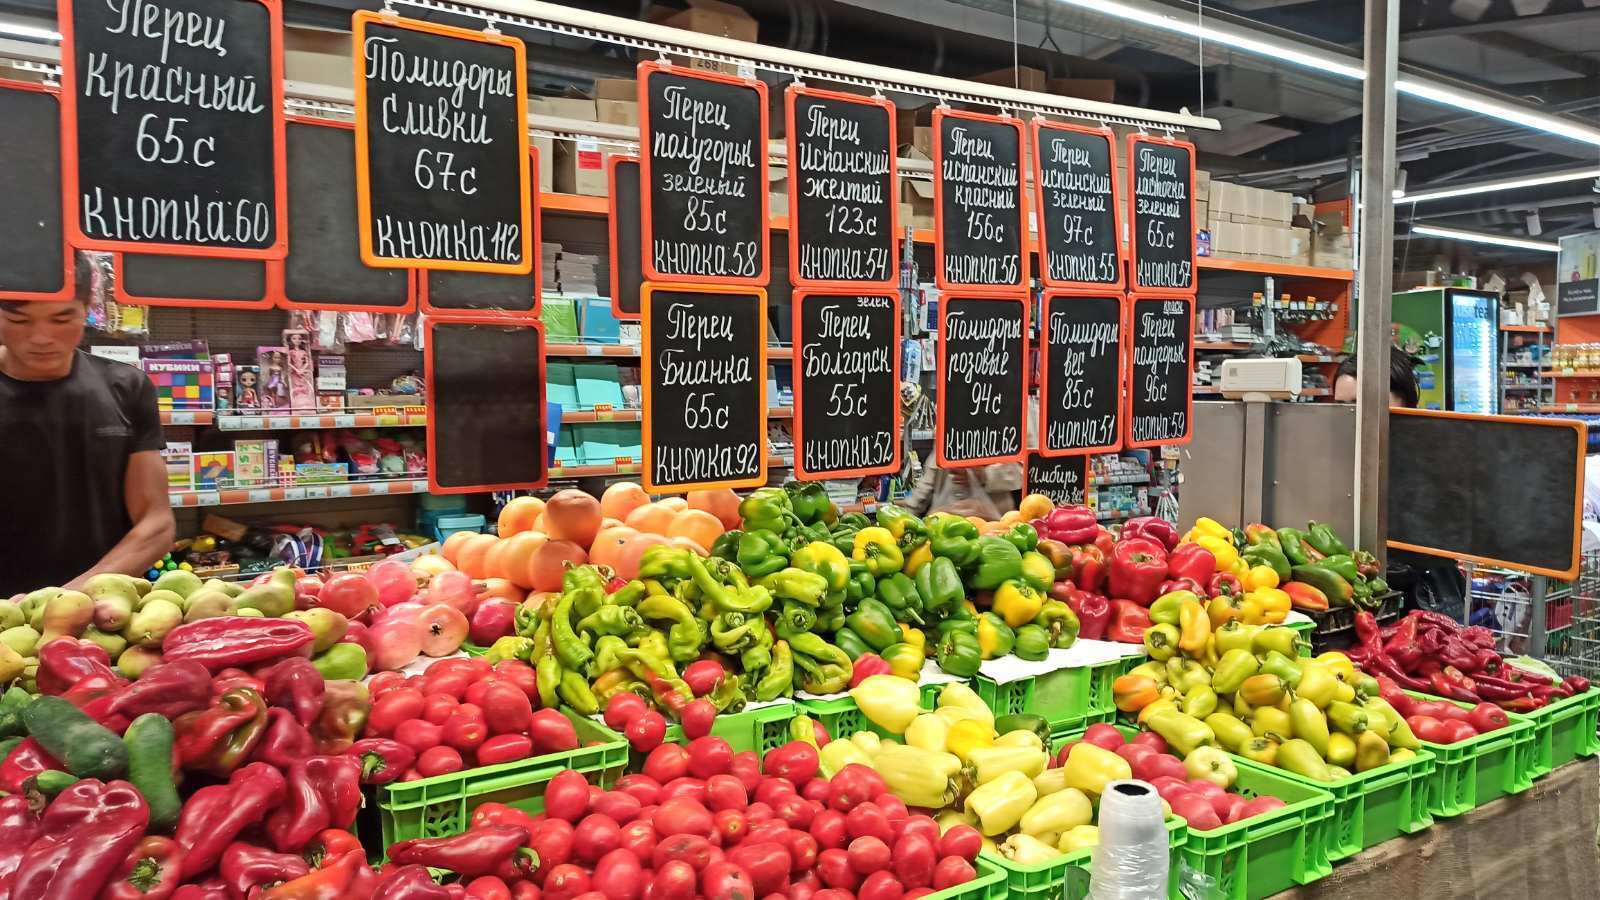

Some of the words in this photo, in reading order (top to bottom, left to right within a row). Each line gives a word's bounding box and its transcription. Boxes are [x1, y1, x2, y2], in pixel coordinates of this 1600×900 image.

[106, 0, 227, 64] Перец
[85, 52, 266, 114] Красный
[364, 36, 514, 109] Помидоры
[383, 93, 493, 144] Сливки
[662, 86, 731, 138] Перец
[806, 104, 861, 150] Перец
[653, 131, 756, 177] полугорьк
[950, 126, 995, 163] Перец
[1050, 138, 1092, 173] Перец
[1139, 148, 1177, 183] Перец
[662, 173, 745, 197] зеленый
[856, 297, 890, 308] зелен
[666, 303, 734, 351] Перец
[818, 305, 871, 349] Перец
[946, 311, 1021, 353] Помидоры
[1140, 312, 1176, 346] Перец
[659, 349, 752, 386] Бианка
[803, 343, 892, 383] Болгарск
[948, 348, 1009, 383] розовые
[1063, 347, 1086, 377] вес
[1133, 341, 1186, 375] полугорьк
[1028, 464, 1078, 490] Имбирь
